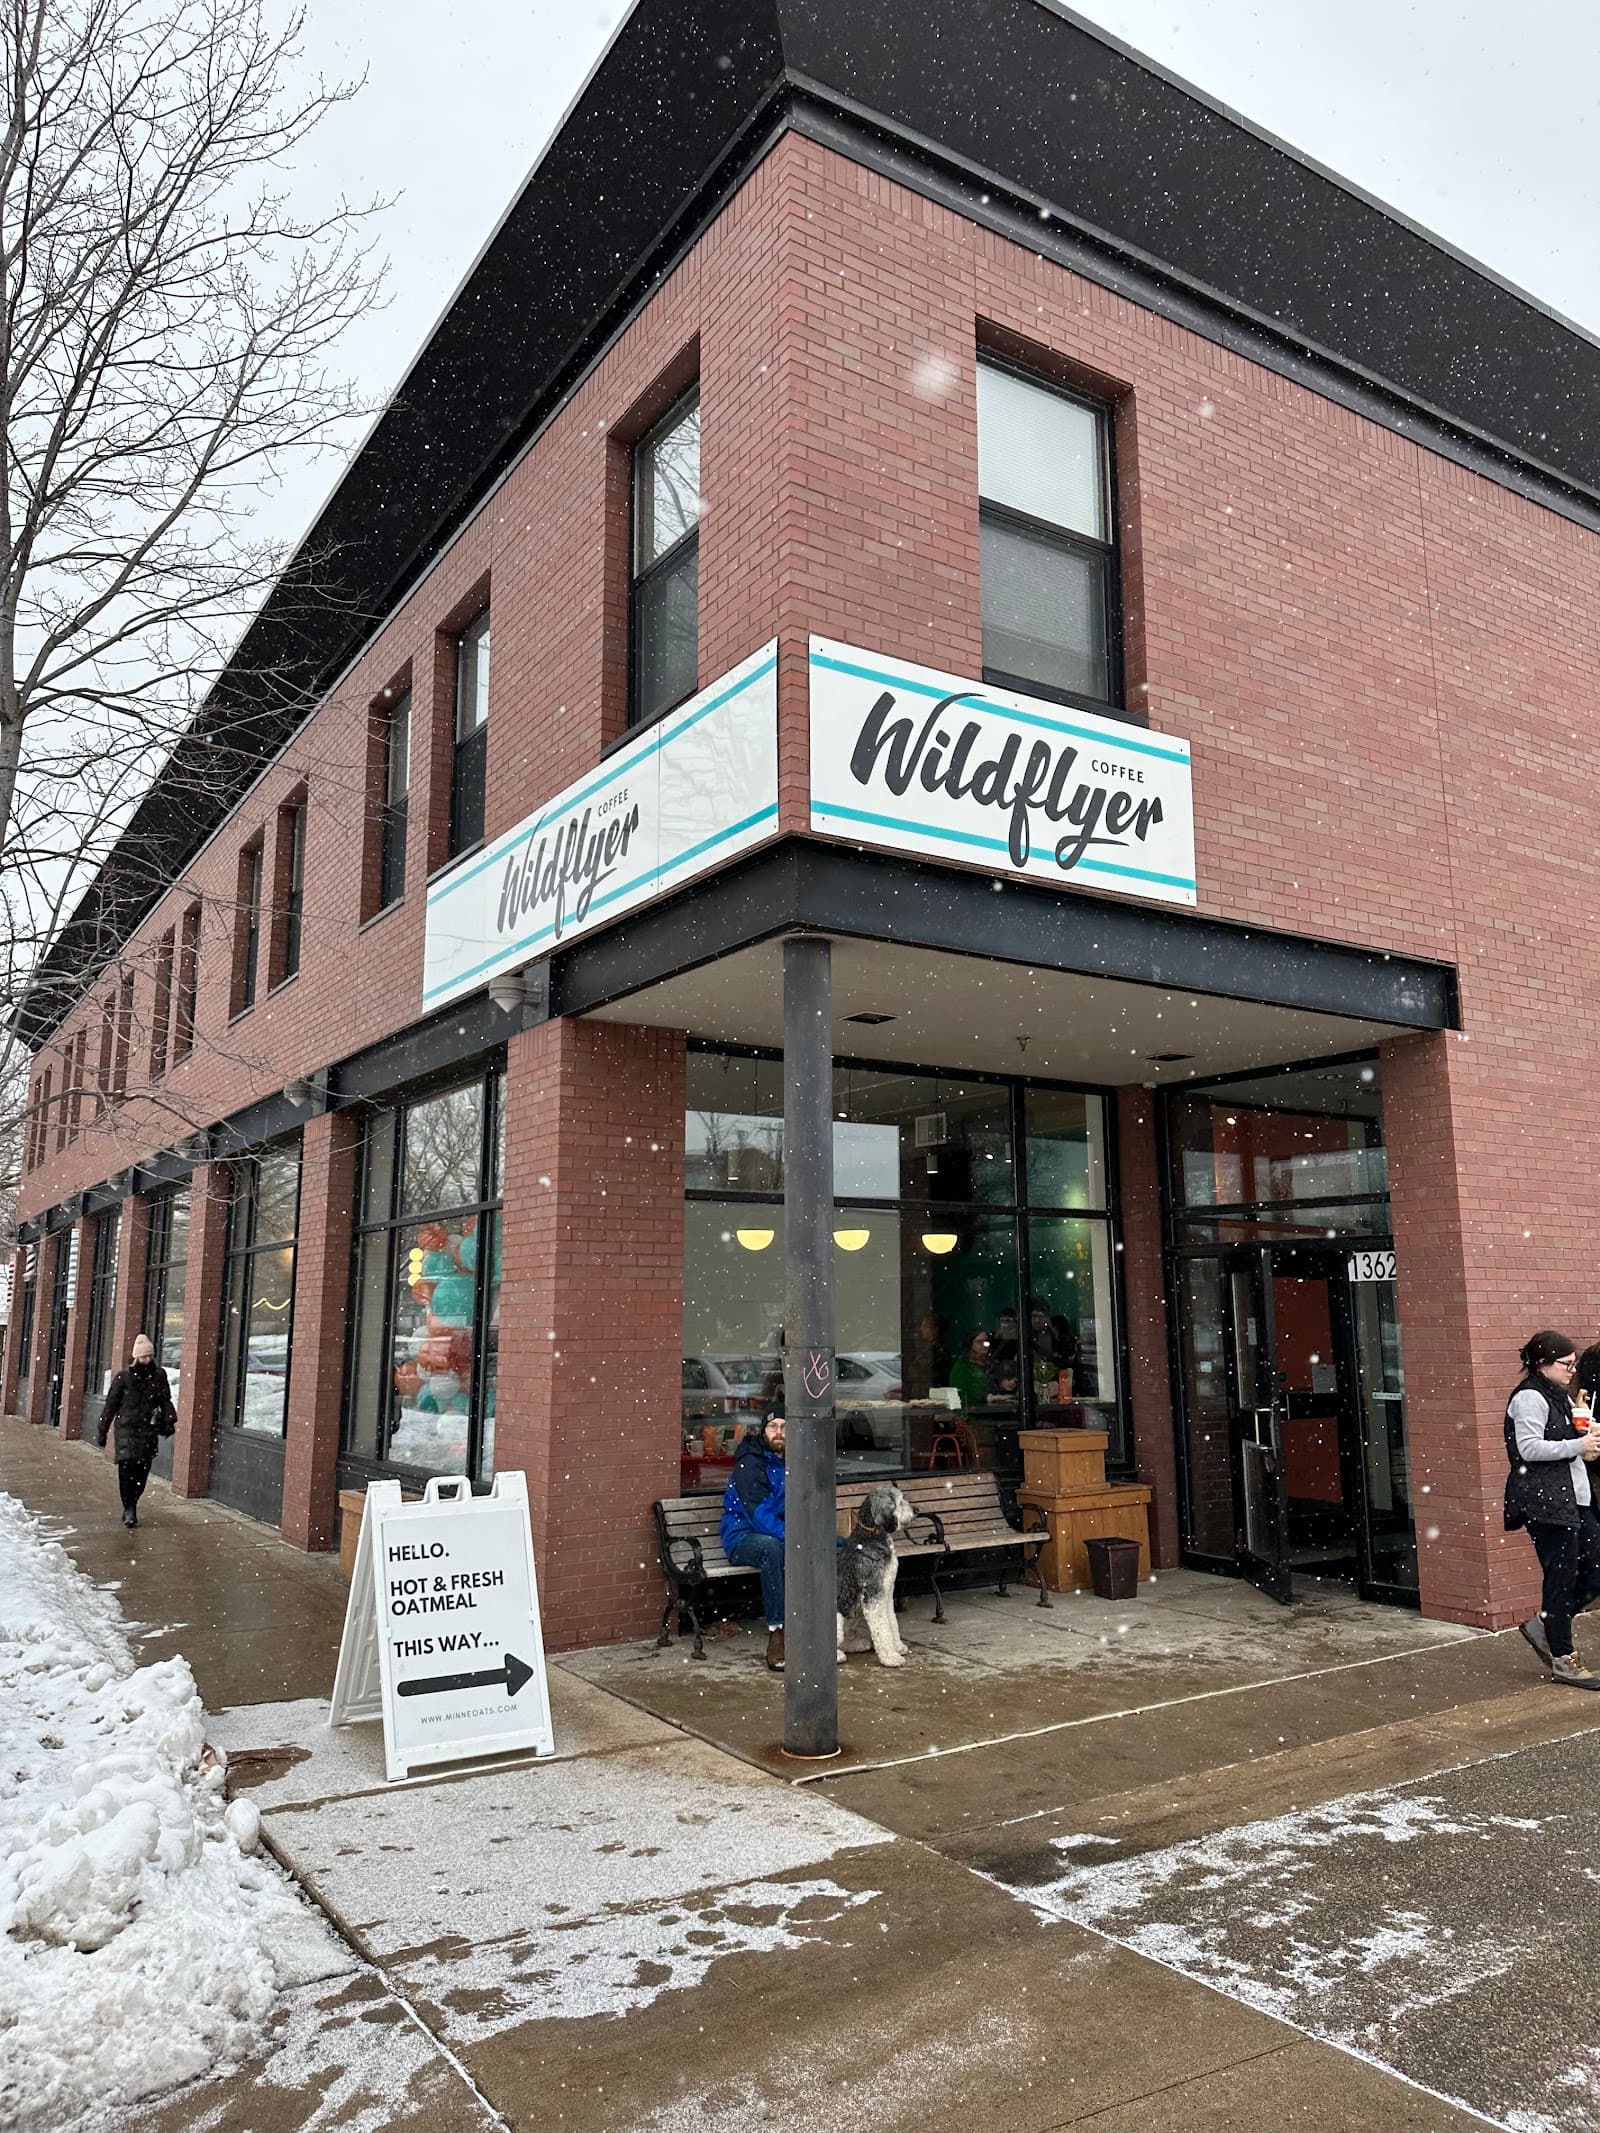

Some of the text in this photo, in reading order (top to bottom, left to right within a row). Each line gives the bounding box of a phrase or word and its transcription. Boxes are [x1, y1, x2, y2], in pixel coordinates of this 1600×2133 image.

[850, 691, 1163, 870] Wildflyer
[1091, 759, 1145, 784] COFFEE
[598, 788, 629, 817] COFFEE
[497, 803, 639, 940] Wildflyer
[1352, 1252, 1397, 1280] 1362
[389, 1542, 450, 1562] HELLO.
[391, 1570, 504, 1596] HOT & FRESH
[391, 1592, 477, 1616] OATMEAL
[393, 1632, 499, 1658] THIS WAY...
[421, 1704, 518, 1724] WWW.MINNEOATS.COM
